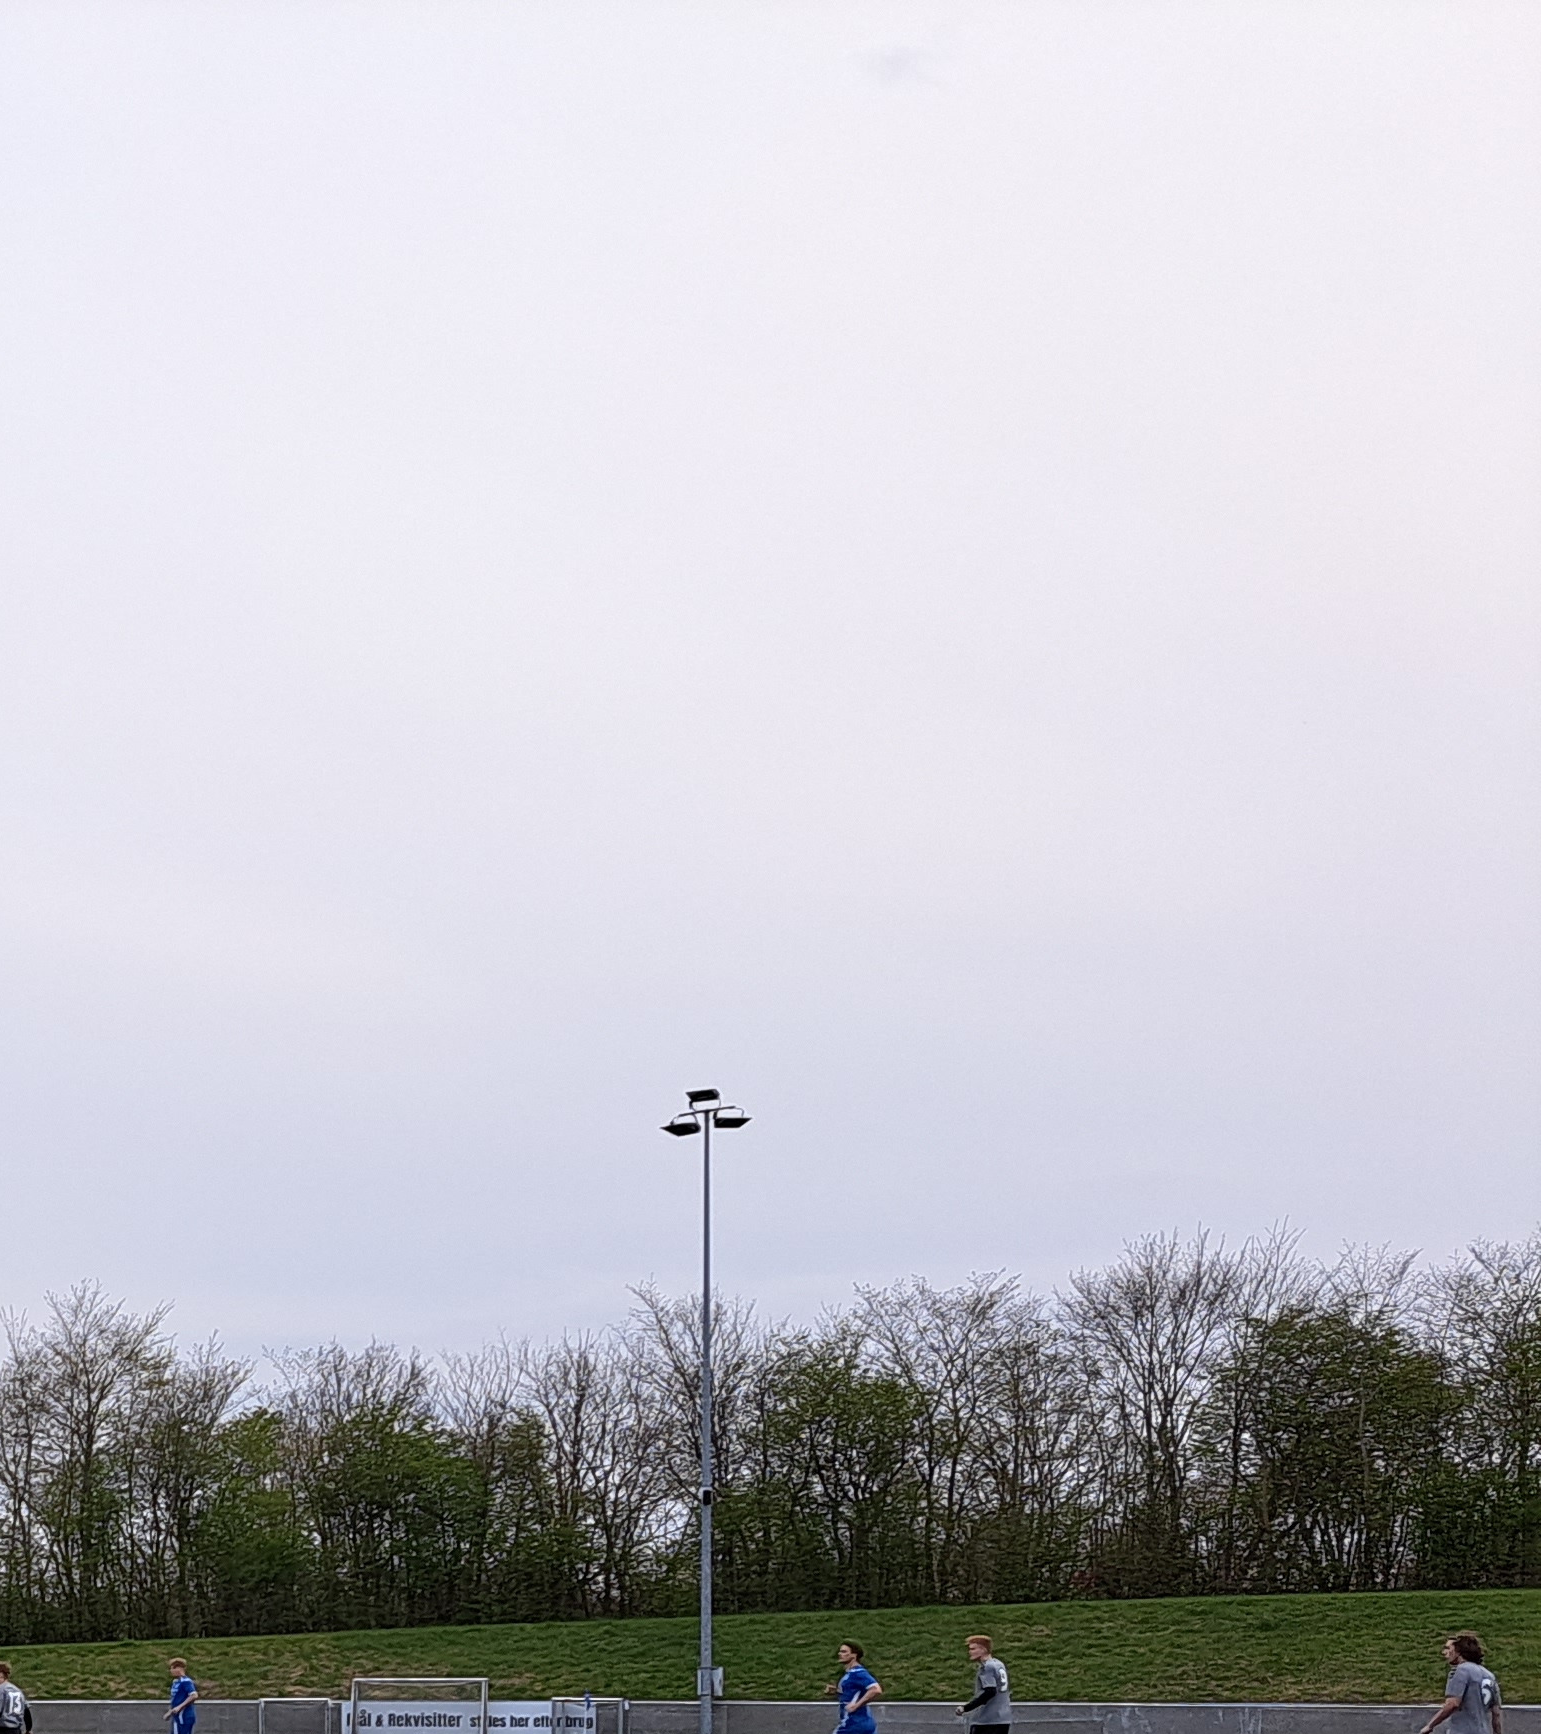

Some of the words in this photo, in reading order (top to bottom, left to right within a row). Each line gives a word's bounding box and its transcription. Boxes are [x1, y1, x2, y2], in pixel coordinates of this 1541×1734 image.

[8, 1691, 22, 1715] 13
[388, 1712, 463, 1727] Rekvisitter
[510, 1715, 530, 1727] her
